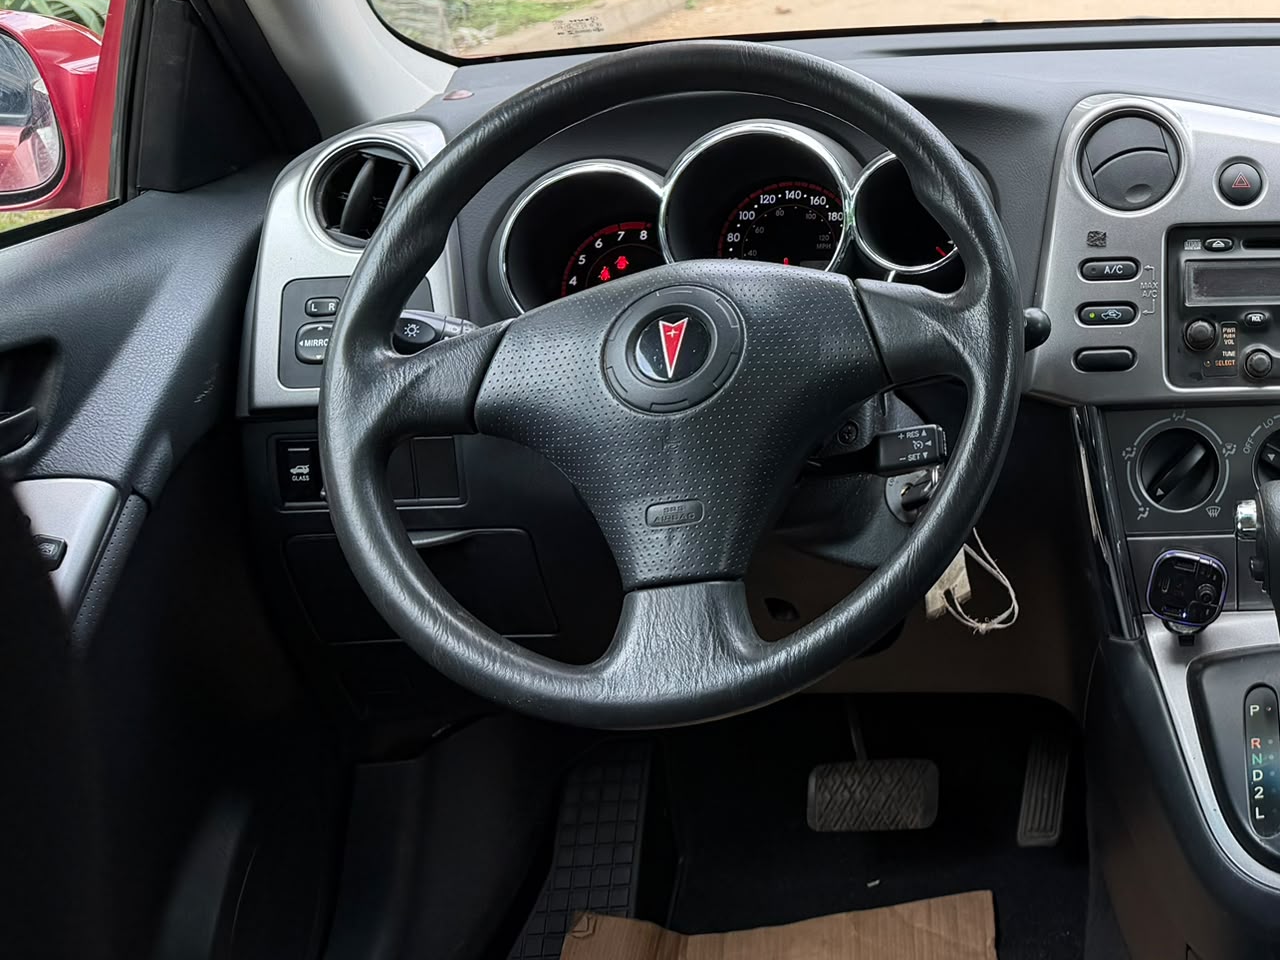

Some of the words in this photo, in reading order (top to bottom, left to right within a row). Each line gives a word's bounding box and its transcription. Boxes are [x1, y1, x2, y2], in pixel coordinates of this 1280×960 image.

[760, 194, 776, 204] 120
[785, 190, 802, 199] 140
[810, 196, 826, 205] 160
[739, 211, 755, 220] 100
[828, 212, 843, 221] 180
[755, 226, 764, 234] 60
[617, 231, 625, 241] 7
[639, 230, 648, 240] 8
[727, 233, 740, 242] 80
[595, 238, 603, 248] 6
[578, 255, 586, 265] 5
[1104, 265, 1123, 274] A/C
[569, 275, 577, 286] 4
[1140, 281, 1159, 289] MAX
[1142, 290, 1158, 298] A/C
[311, 303, 318, 312] L
[328, 302, 335, 311] R
[304, 339, 328, 347] MIRRO
[1263, 418, 1274, 429] LO
[906, 430, 920, 438] RES
[1243, 437, 1254, 454] OFF
[907, 452, 921, 461] SET
[1250, 704, 1260, 717] P
[1251, 737, 1261, 750] R
[1252, 753, 1263, 765] N
[1252, 769, 1264, 781] D
[1254, 786, 1264, 799] 2
[1255, 806, 1265, 819] L
